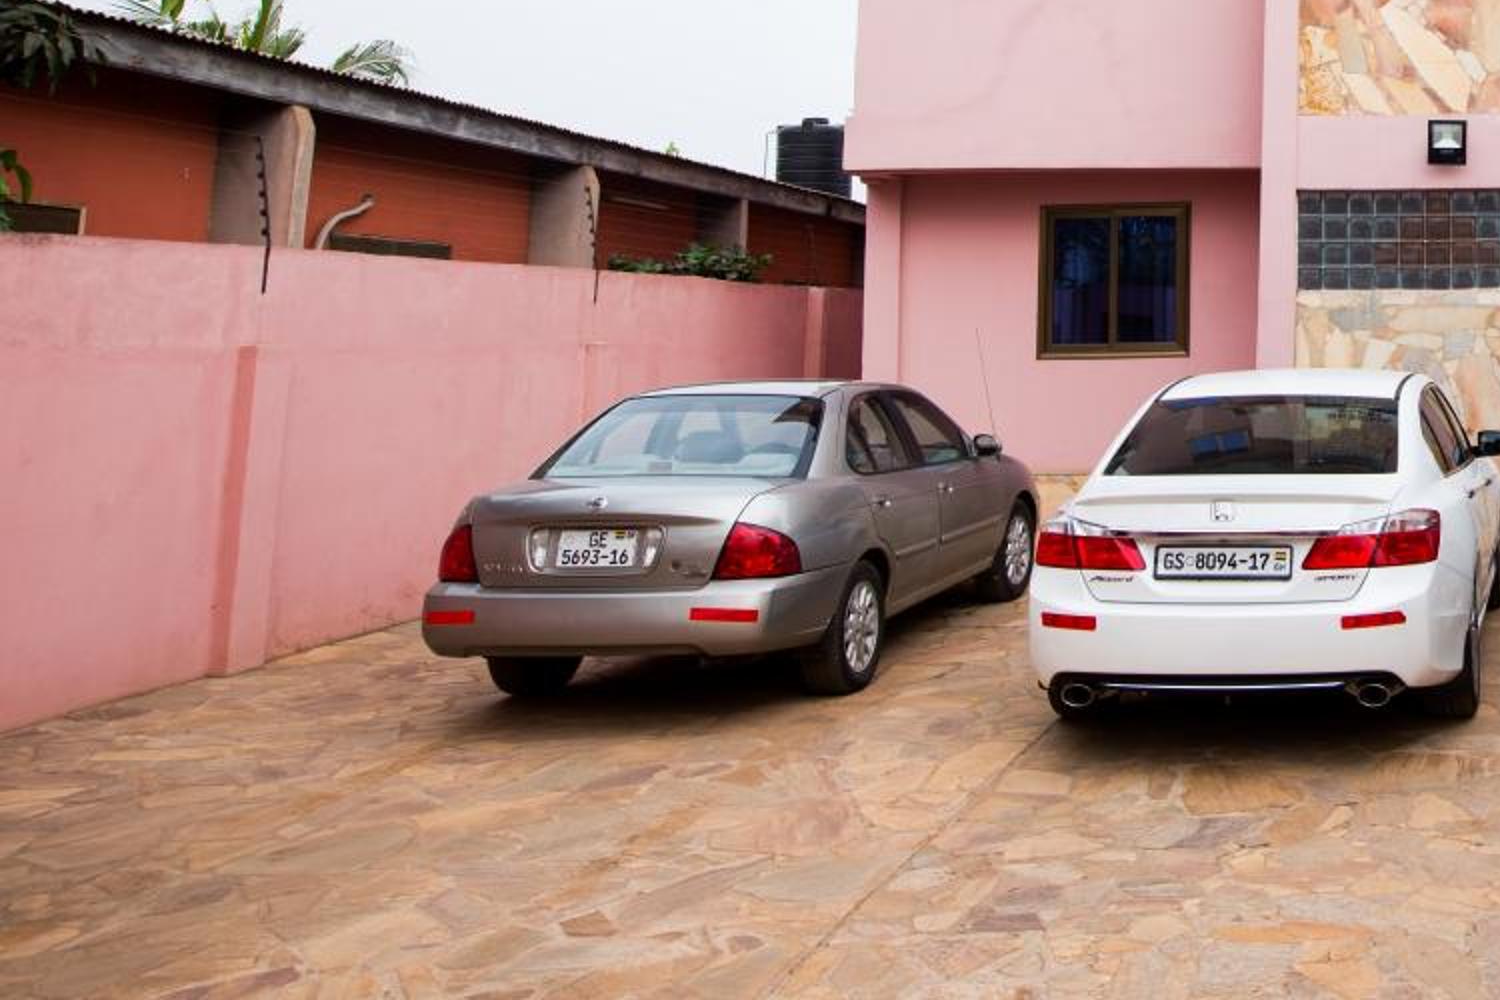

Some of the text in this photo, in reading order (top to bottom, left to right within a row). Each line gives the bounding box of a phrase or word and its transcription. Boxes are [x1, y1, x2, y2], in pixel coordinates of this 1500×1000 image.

[588, 531, 608, 548] GE
[560, 549, 629, 566] 5693-16
[1163, 552, 1270, 571] GS 8094-17
